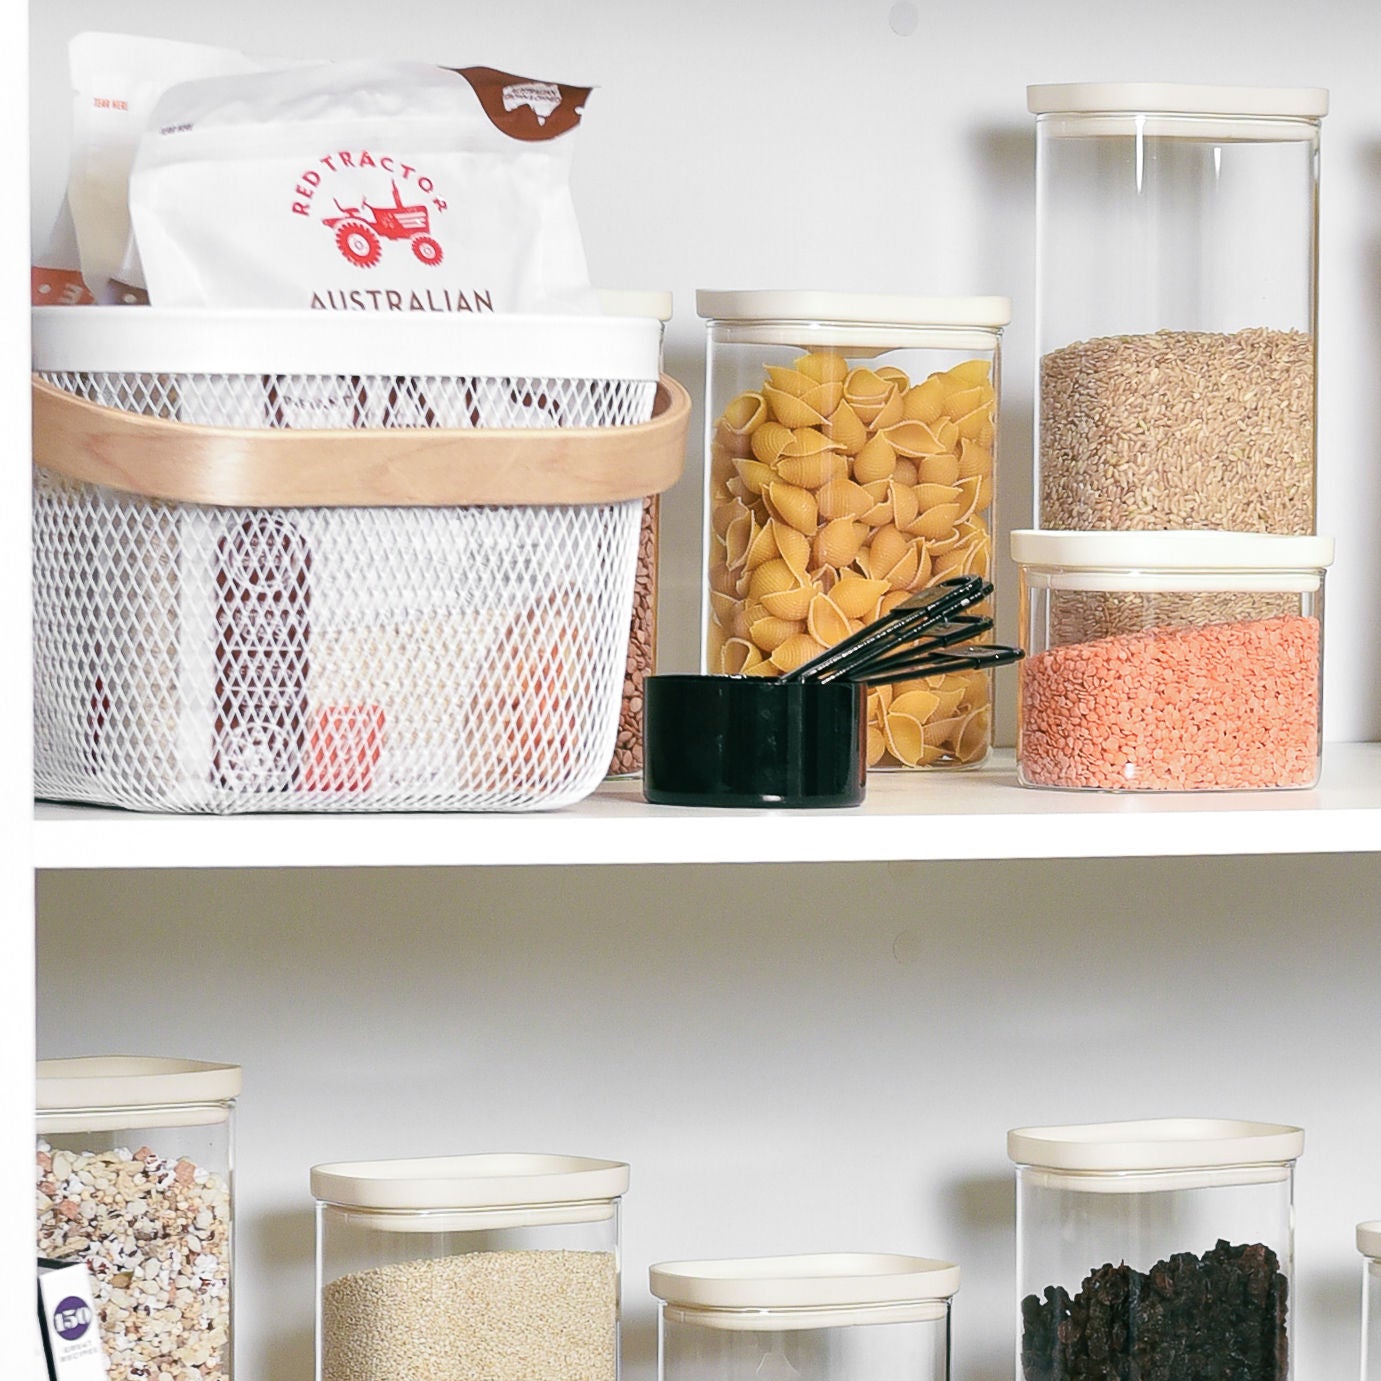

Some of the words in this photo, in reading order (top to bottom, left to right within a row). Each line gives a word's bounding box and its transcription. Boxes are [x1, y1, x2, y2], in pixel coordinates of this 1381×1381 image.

[292, 170, 321, 217] RED
[320, 150, 448, 213] TRACTOR
[310, 289, 494, 313] AUSTRALIAN
[55, 1306, 93, 1333] 150
